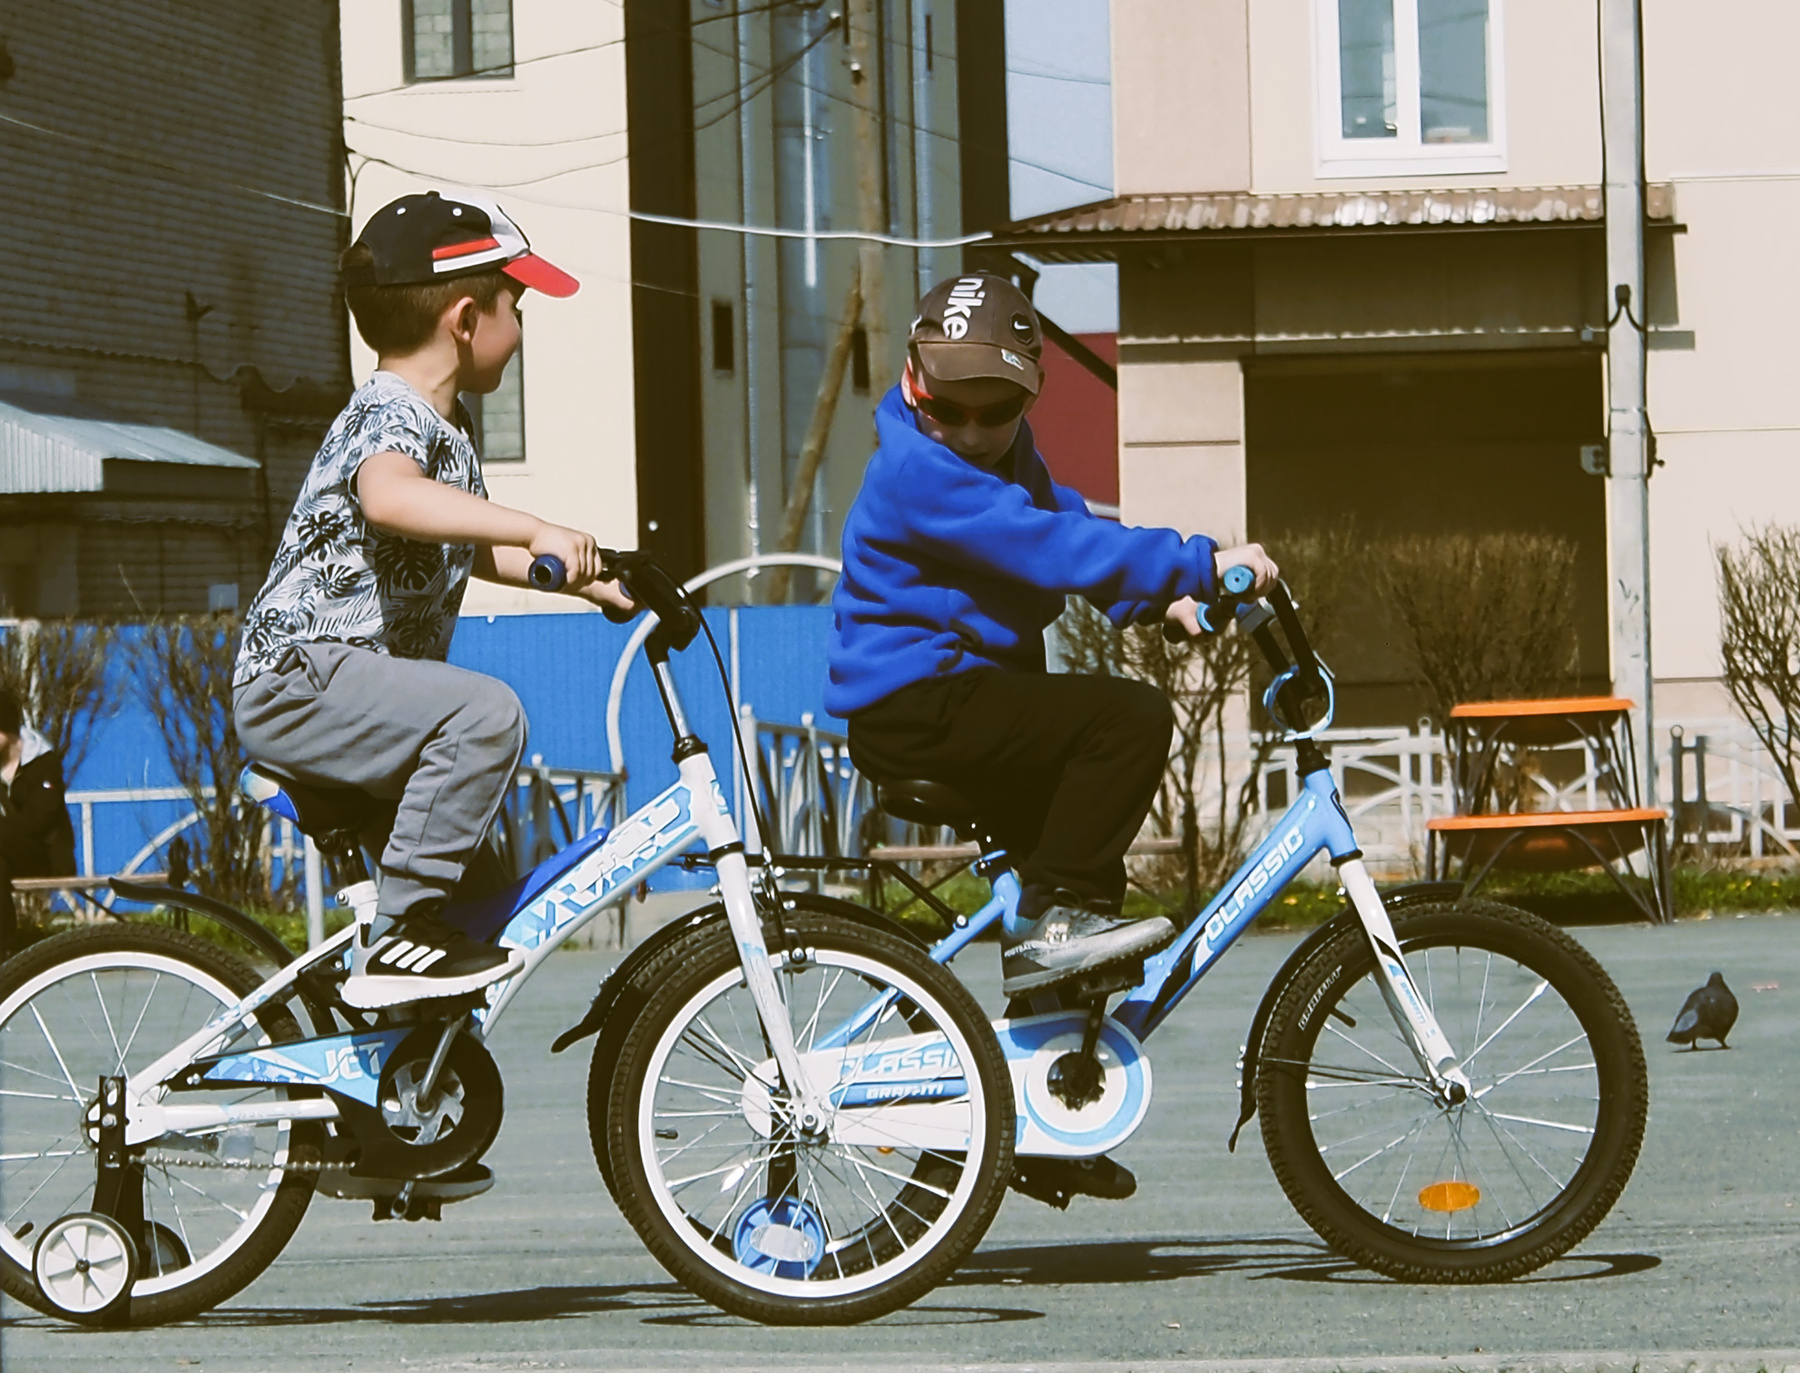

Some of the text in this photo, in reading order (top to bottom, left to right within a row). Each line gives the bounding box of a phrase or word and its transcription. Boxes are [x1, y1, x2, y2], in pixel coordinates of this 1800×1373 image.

[942, 277, 986, 340] nike
[1204, 826, 1304, 941] CLASSIC
[319, 1041, 385, 1084] JET
